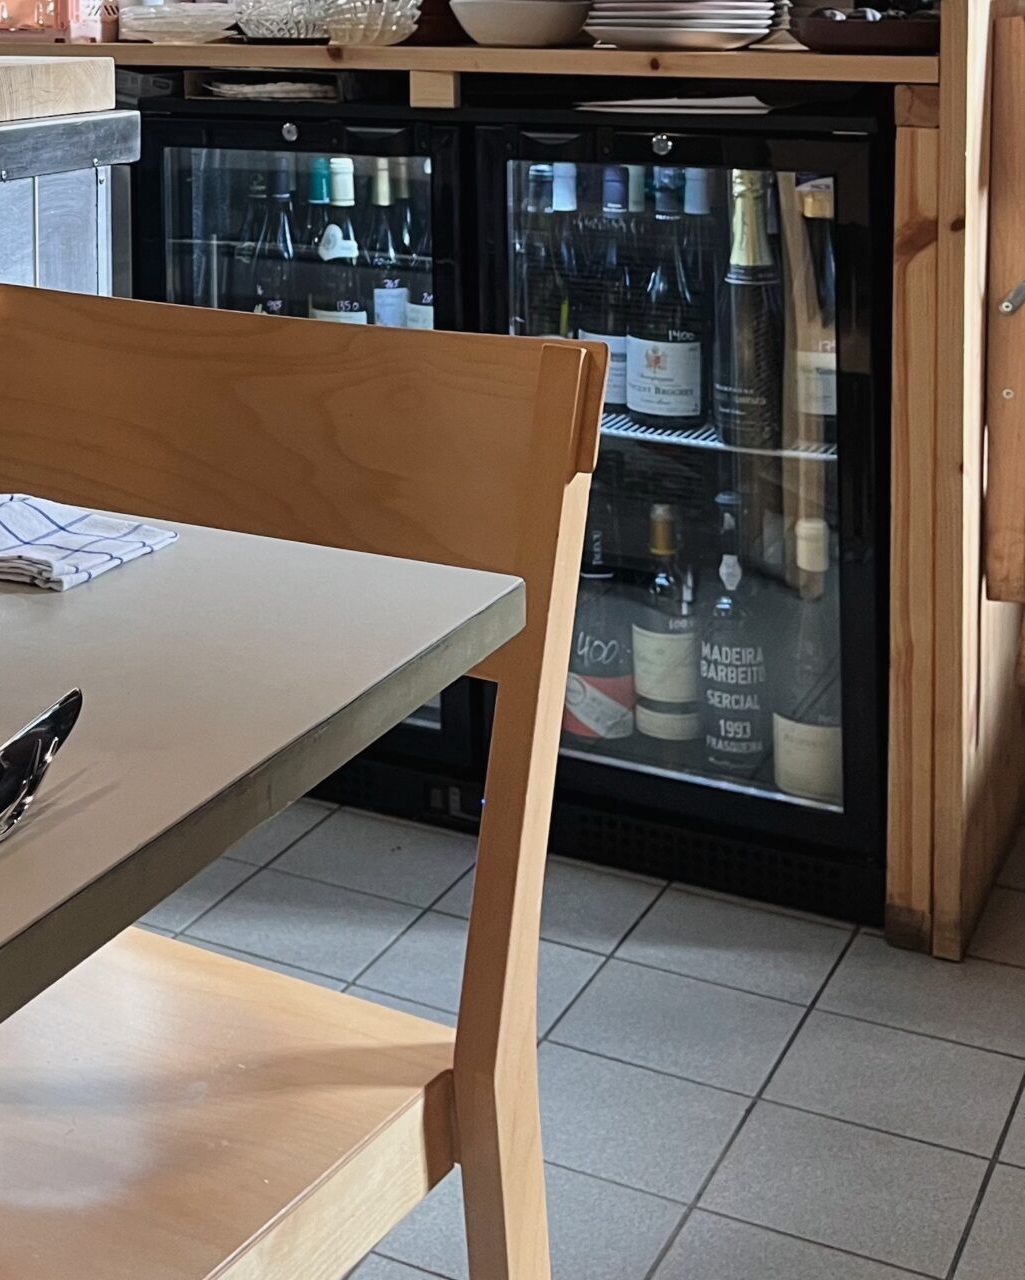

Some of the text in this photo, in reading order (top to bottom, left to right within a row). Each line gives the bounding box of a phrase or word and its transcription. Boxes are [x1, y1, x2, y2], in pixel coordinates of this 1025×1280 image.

[701, 639, 764, 665] MADEIRA
[706, 689, 761, 711] SERCIAL
[719, 718, 751, 739] 1993
